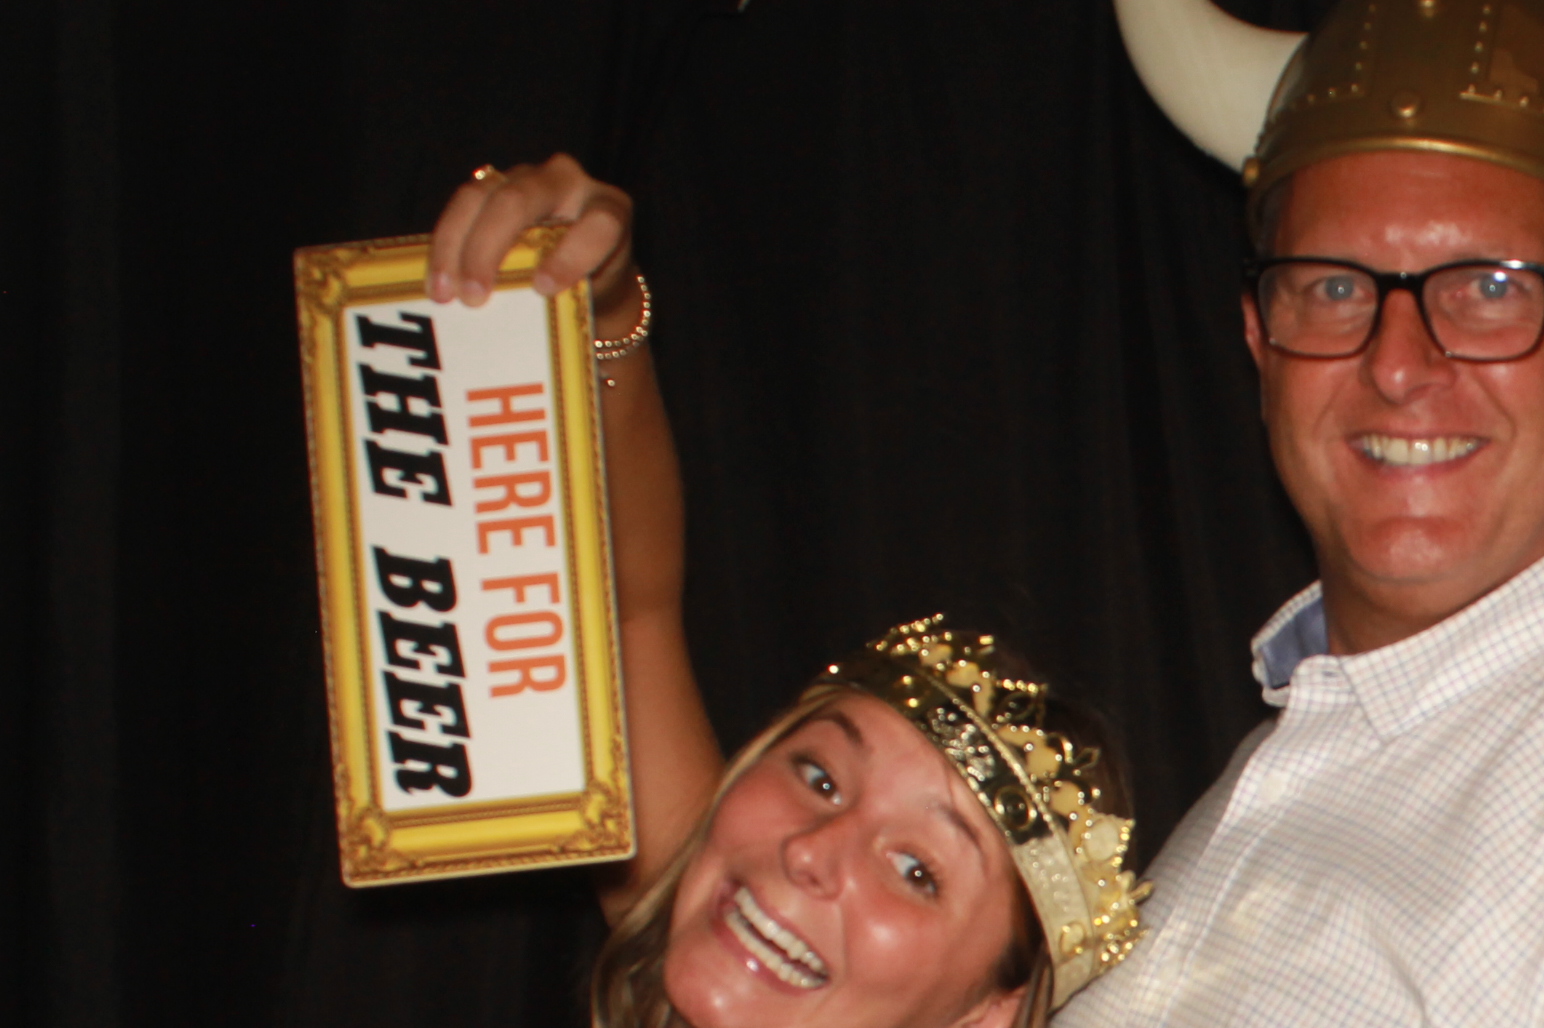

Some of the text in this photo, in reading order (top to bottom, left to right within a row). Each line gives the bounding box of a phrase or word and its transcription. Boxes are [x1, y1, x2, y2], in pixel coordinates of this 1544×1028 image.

[355, 311, 474, 799] THE BEER
[465, 383, 568, 699] HERE FOR
